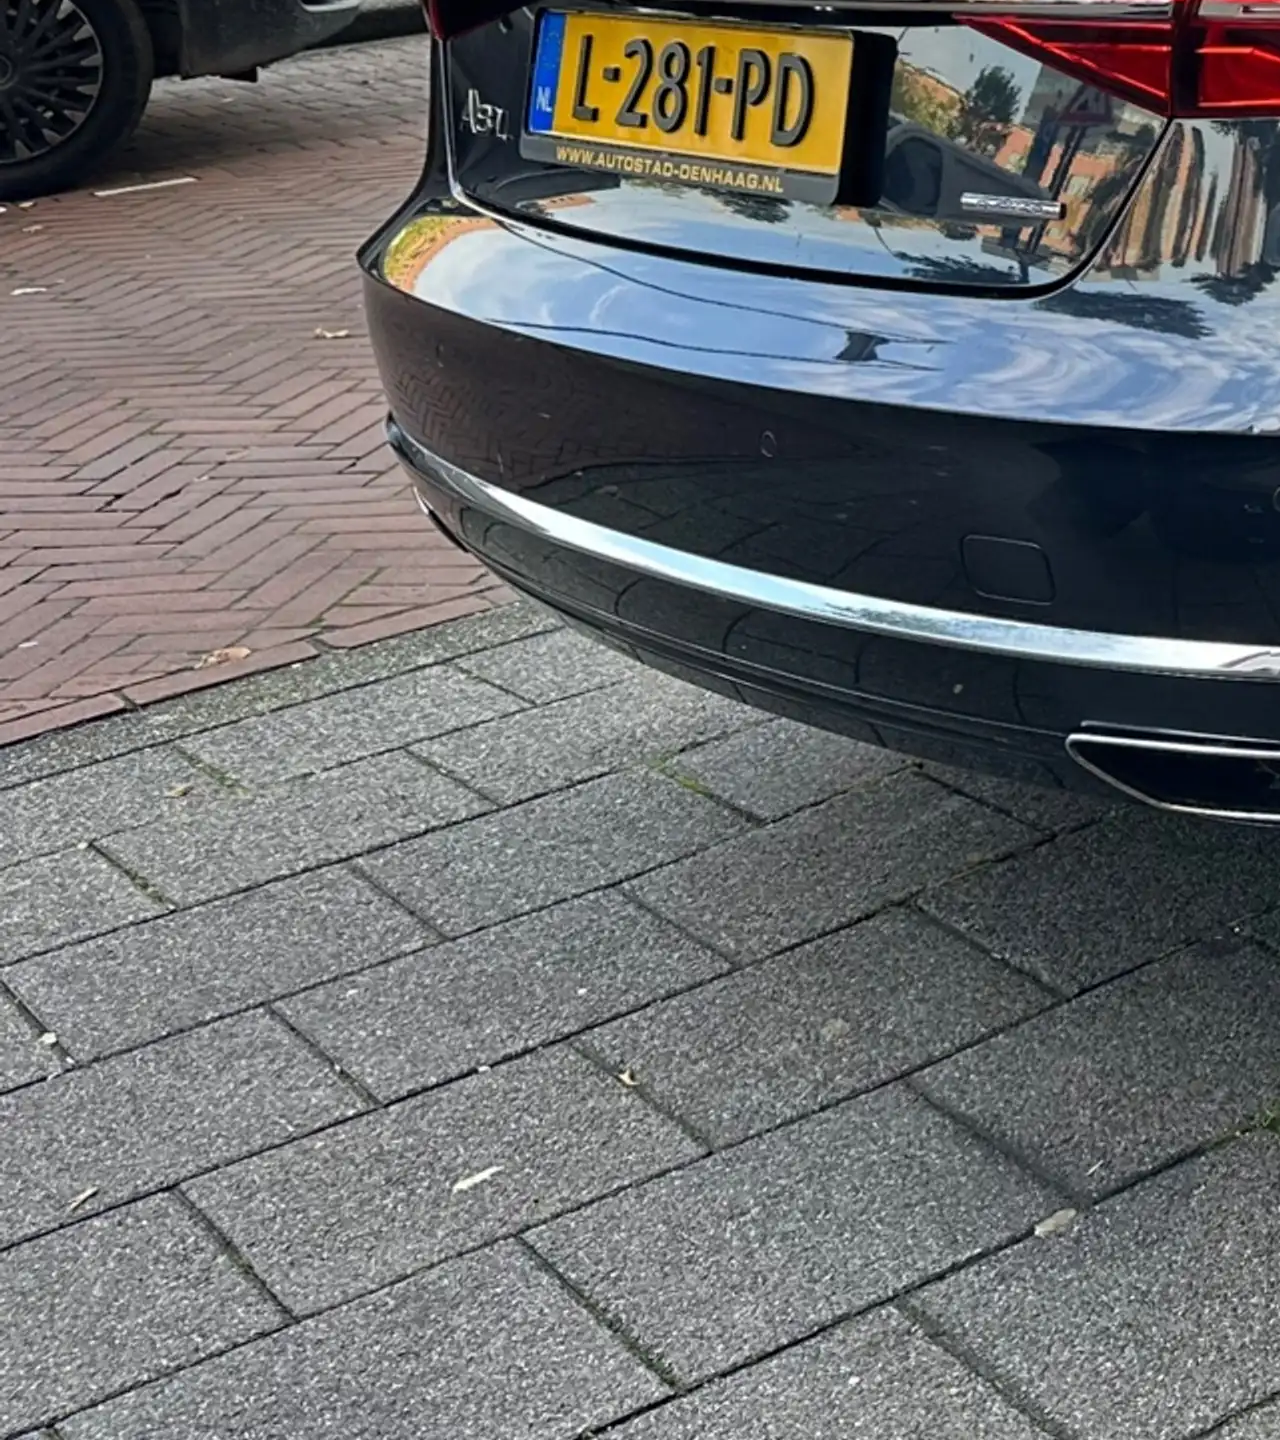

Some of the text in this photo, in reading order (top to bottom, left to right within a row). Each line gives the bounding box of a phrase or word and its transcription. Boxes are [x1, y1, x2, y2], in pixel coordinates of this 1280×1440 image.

[536, 86, 553, 112] NL
[572, 34, 815, 148] L-281-PD
[556, 146, 784, 193] WWW.AUTOSTAD-DENHAAG.NL
